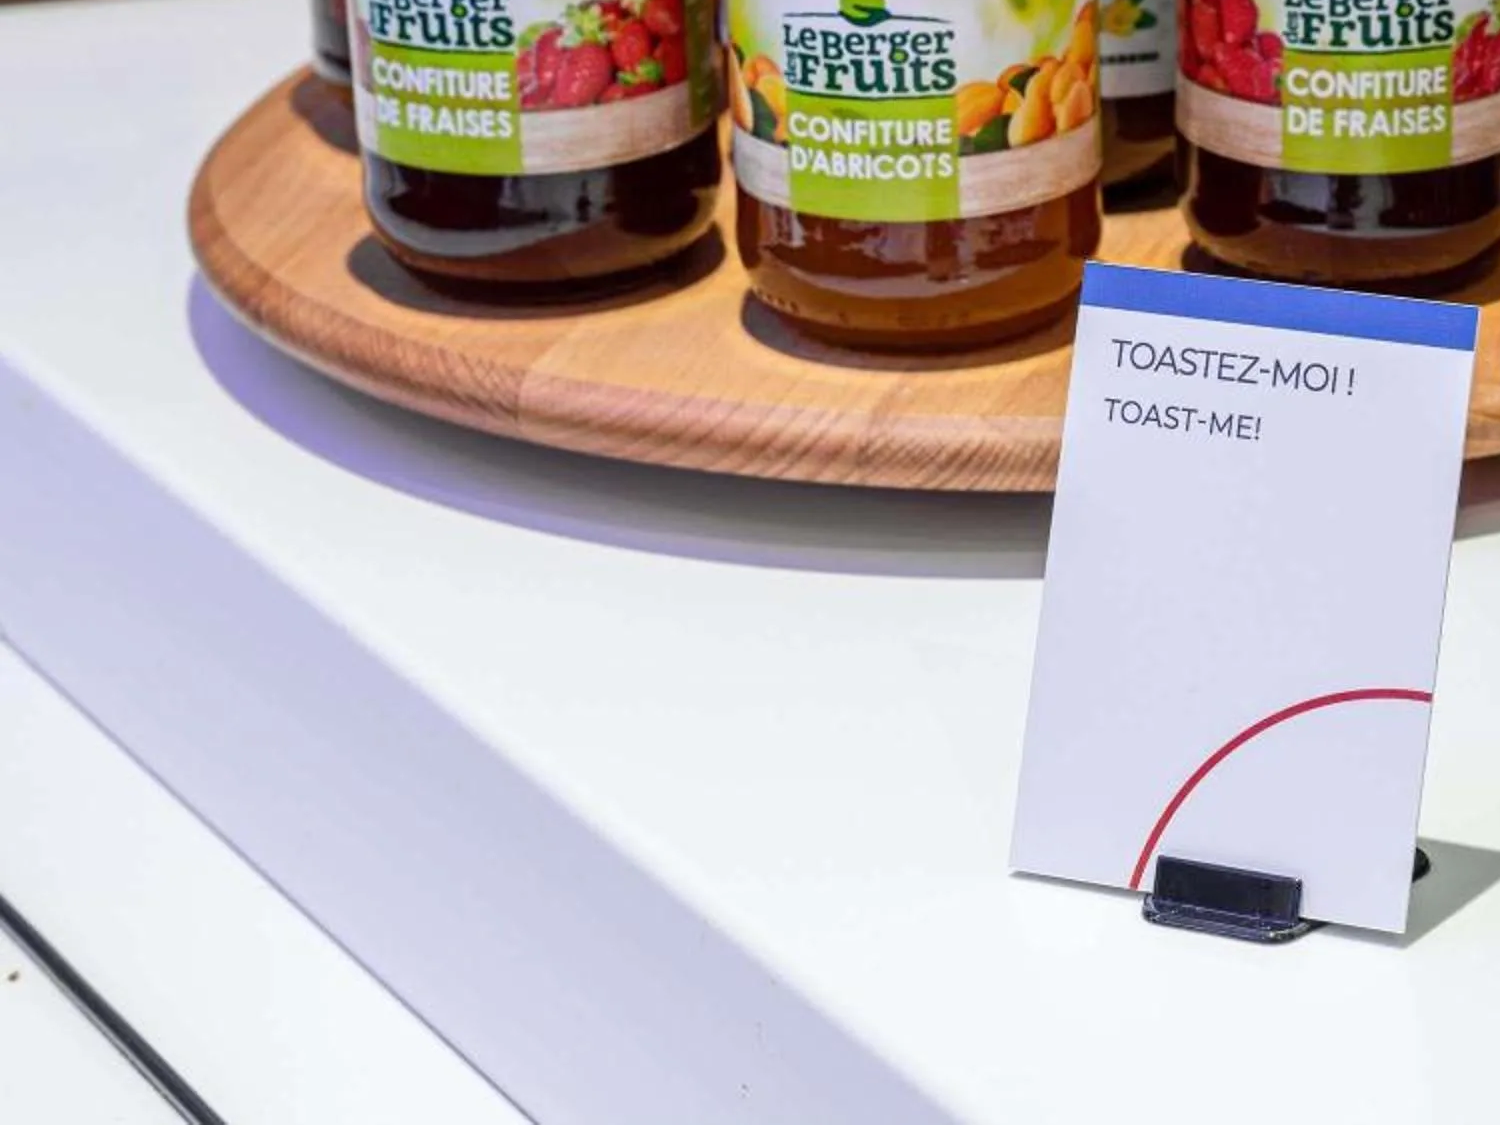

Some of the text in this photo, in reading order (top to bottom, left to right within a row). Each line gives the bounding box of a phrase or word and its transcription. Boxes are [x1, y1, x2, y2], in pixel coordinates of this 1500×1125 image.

[376, 2, 515, 47] Fruits
[1300, 9, 1455, 47] Fruits
[820, 29, 955, 64] Berger
[372, 56, 512, 101] CONFITURE
[798, 53, 957, 93] Fruits
[1286, 65, 1448, 99] CONFITURE
[377, 94, 513, 138] DE FRAISES
[788, 111, 953, 147] CONFITURE
[1287, 104, 1447, 138] DE FRAISES
[790, 144, 953, 180] D'ABRICOTS
[1111, 338, 1339, 396] TOASTEZ-MOI
[1104, 398, 1261, 441] TOAST-ME!
